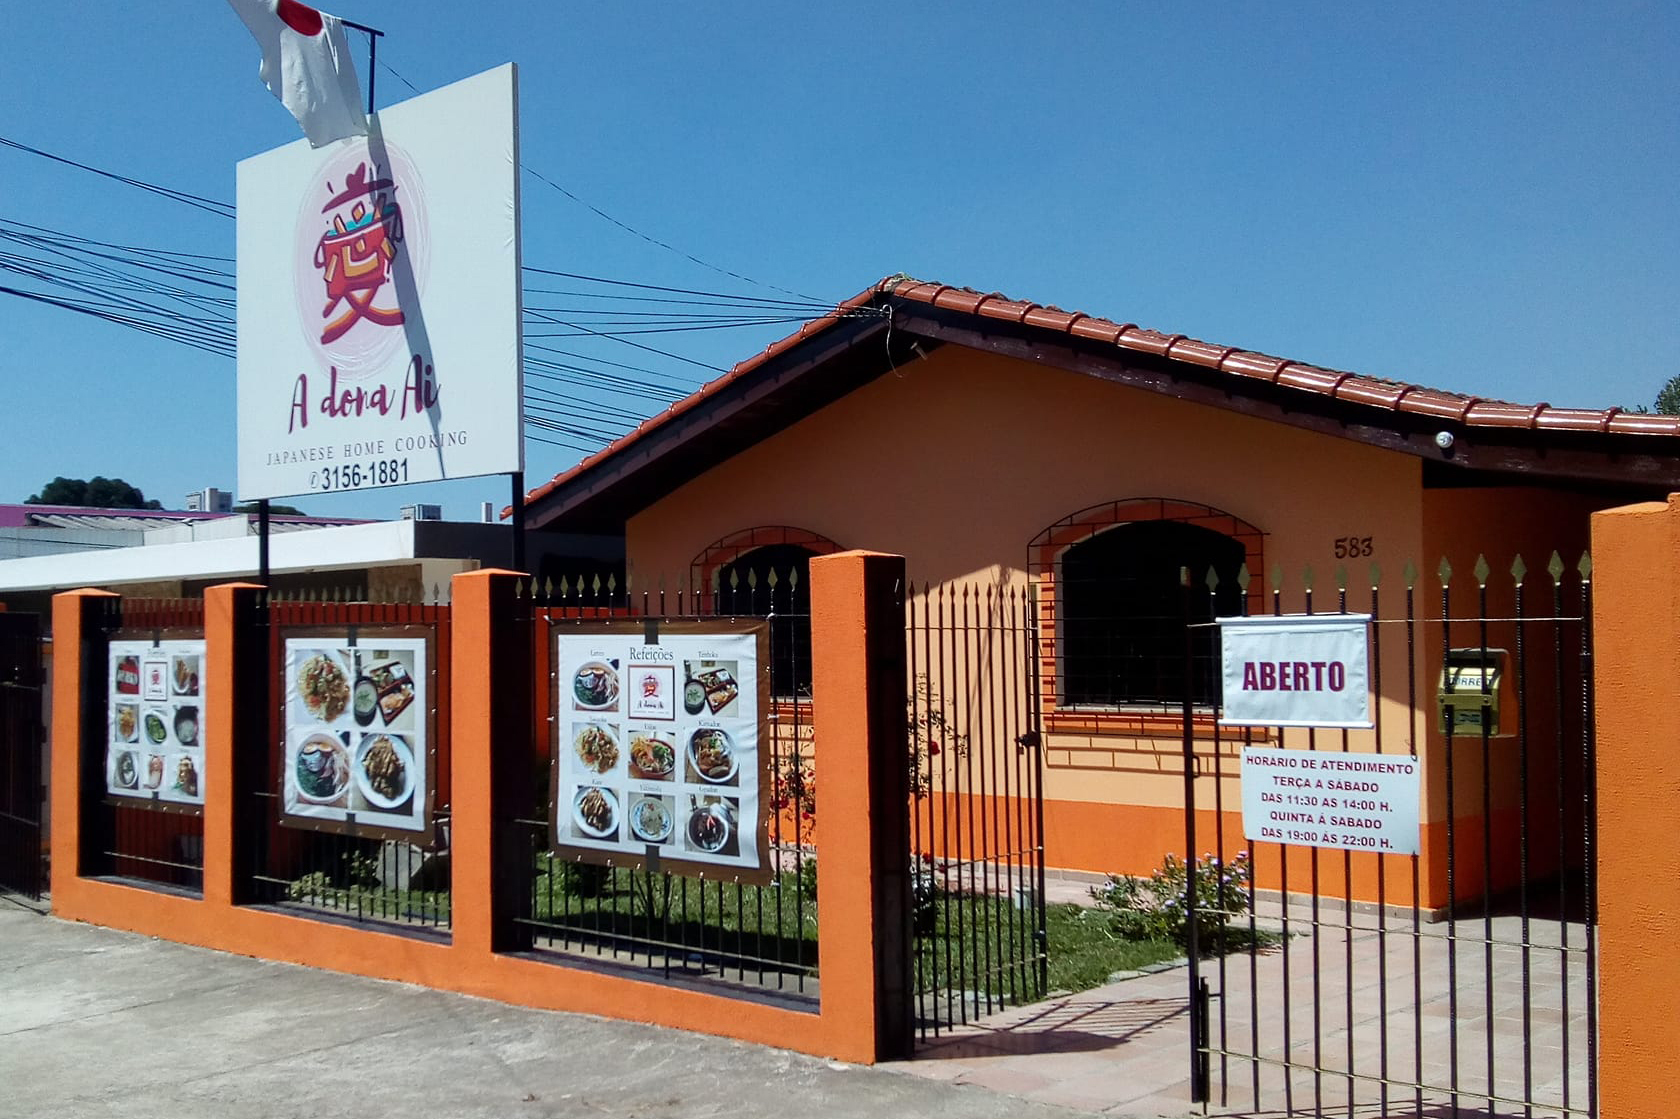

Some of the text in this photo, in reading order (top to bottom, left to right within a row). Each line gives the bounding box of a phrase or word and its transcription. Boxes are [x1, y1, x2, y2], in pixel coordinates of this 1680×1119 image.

[288, 373, 308, 435] A
[400, 353, 442, 421] Ai
[266, 430, 468, 466] JAPANESE HOME COOKING
[321, 457, 408, 490] 3156-1881
[1334, 536, 1373, 559] 583
[629, 646, 674, 663] Refeições
[1242, 660, 1345, 693] ABERTO
[1301, 758, 1317, 769] DE
[1320, 760, 1414, 775] ATENDIMENTO
[1272, 775, 1311, 790] TERÇA
[1327, 778, 1379, 793] SÁBADO
[1261, 792, 1283, 804] DAS
[1287, 795, 1318, 806] 11:30
[1342, 799, 1375, 811] 14:00
[1379, 801, 1393, 812] H.
[1270, 810, 1315, 824] QUINTA
[1261, 827, 1283, 838] DAS
[1287, 830, 1318, 842] 19:00
[1342, 834, 1376, 847] 22:00
[1379, 838, 1393, 849] H.
